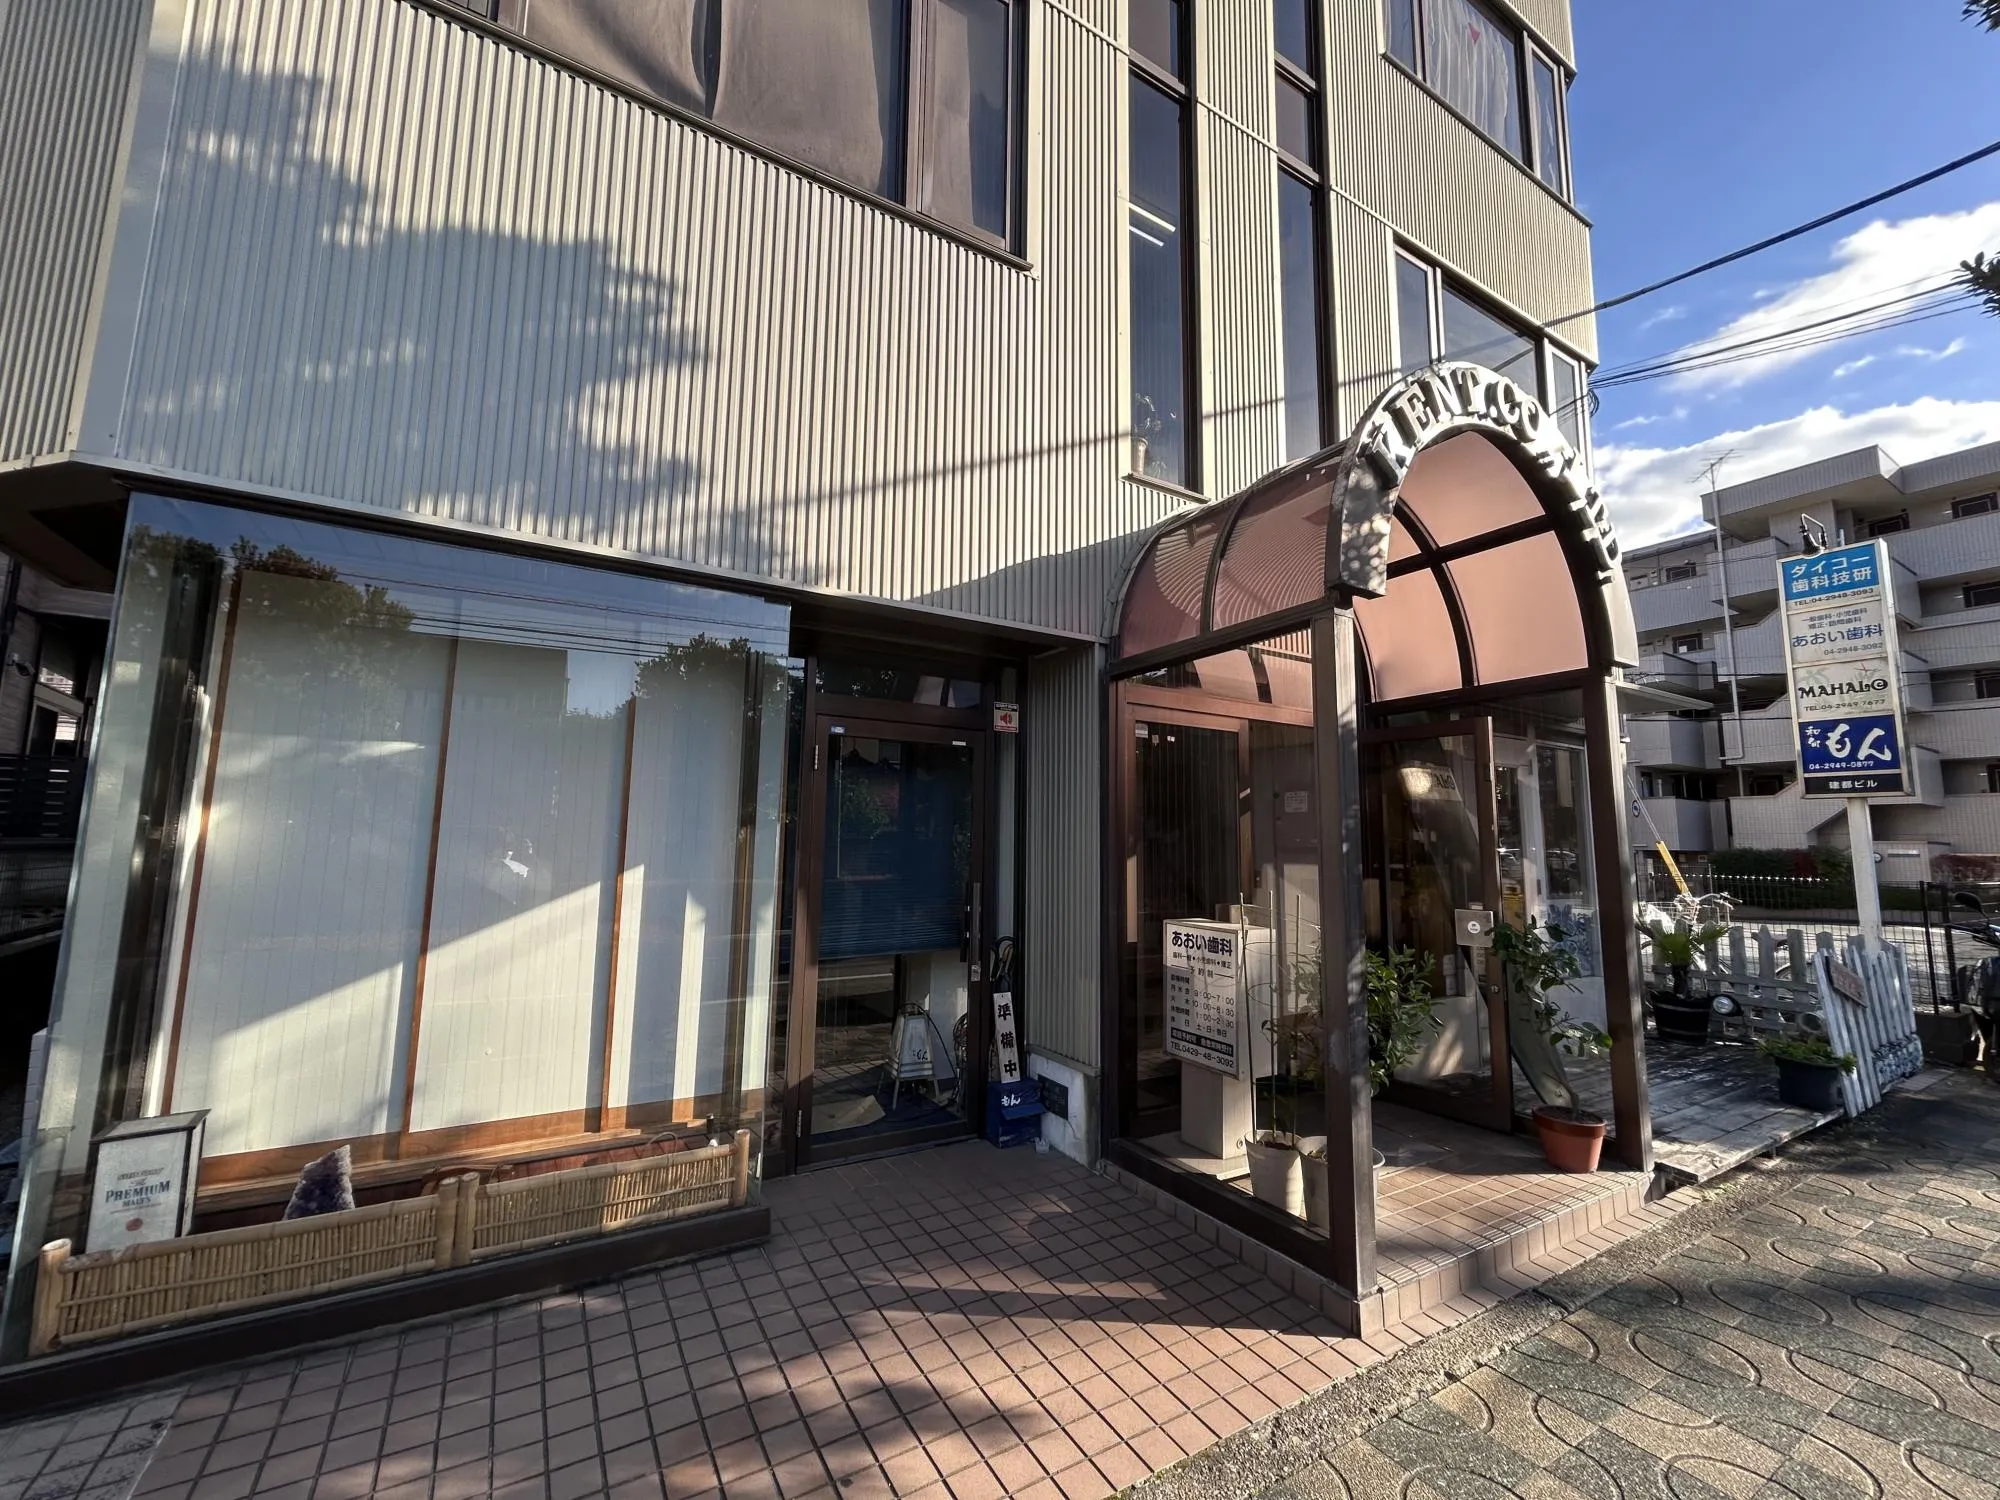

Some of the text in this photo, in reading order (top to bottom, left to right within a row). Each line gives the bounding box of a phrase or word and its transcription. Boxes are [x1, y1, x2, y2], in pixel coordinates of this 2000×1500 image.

[1791, 556, 1870, 578] ダイコー
[1792, 566, 1872, 593] 歯科技研
[1792, 623, 1884, 648] あおい歯科
[1172, 931, 1233, 957] あおい歯科
[997, 1002, 1018, 1077] 準備中
[105, 1180, 170, 1204] PREMIUM
